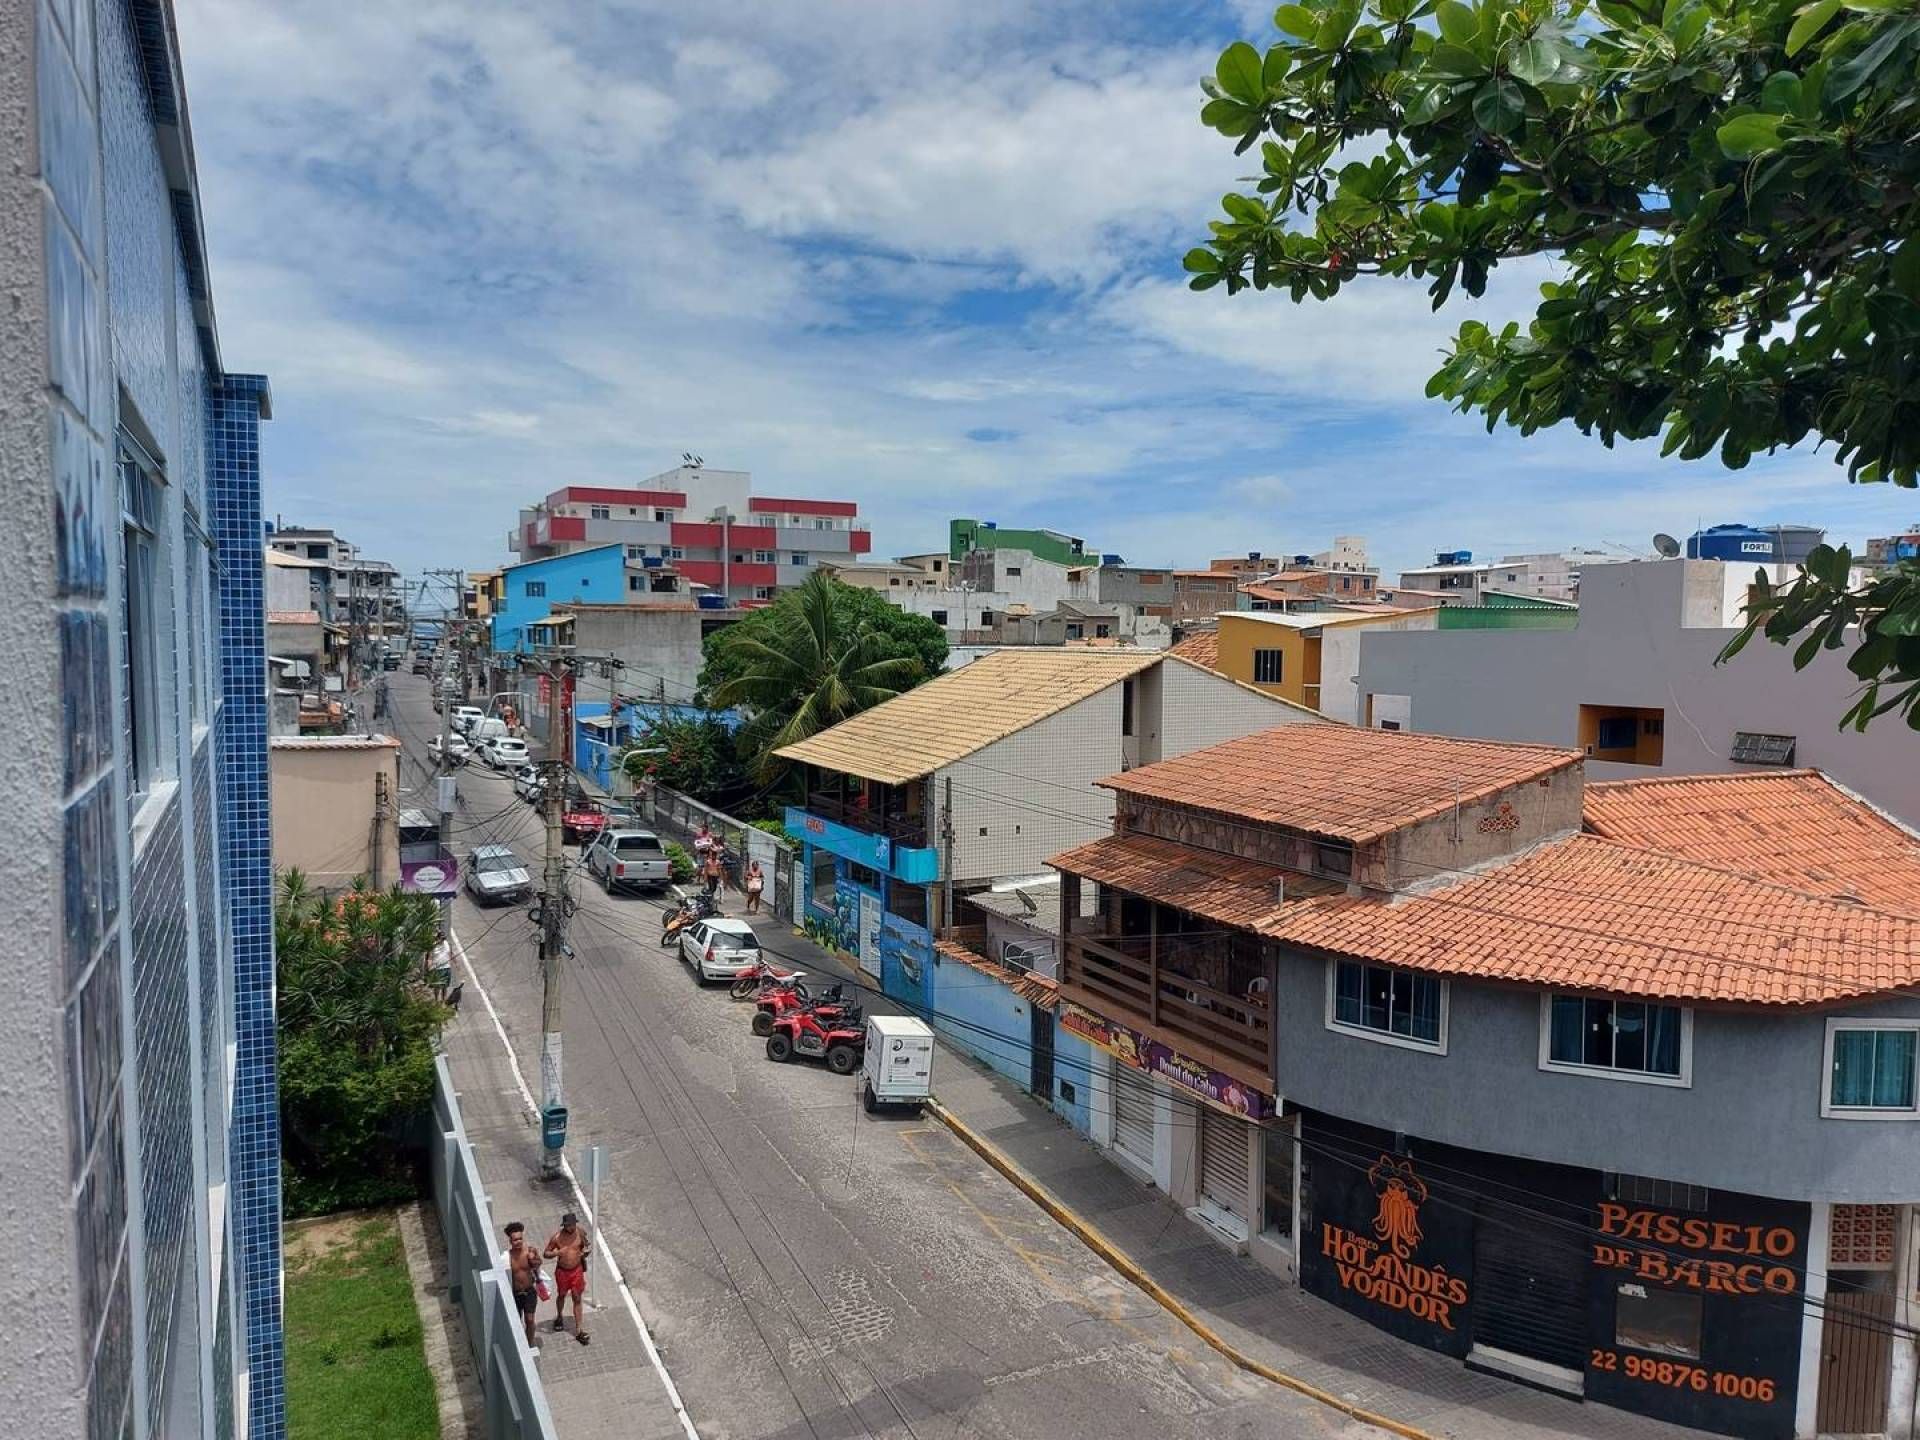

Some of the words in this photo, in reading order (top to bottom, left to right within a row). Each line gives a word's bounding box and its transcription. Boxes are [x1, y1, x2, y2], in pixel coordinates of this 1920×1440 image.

[1597, 1203, 1795, 1257] PASSEIO
[1321, 1222, 1468, 1305] HOLANDÊS
[1593, 1245, 1634, 1268] DE
[1636, 1251, 1796, 1294] BARCO
[1336, 1262, 1457, 1330] VOADOR
[1592, 1350, 1616, 1371] 22
[1624, 1355, 1708, 1391] 99876
[1713, 1372, 1775, 1402] 1006
